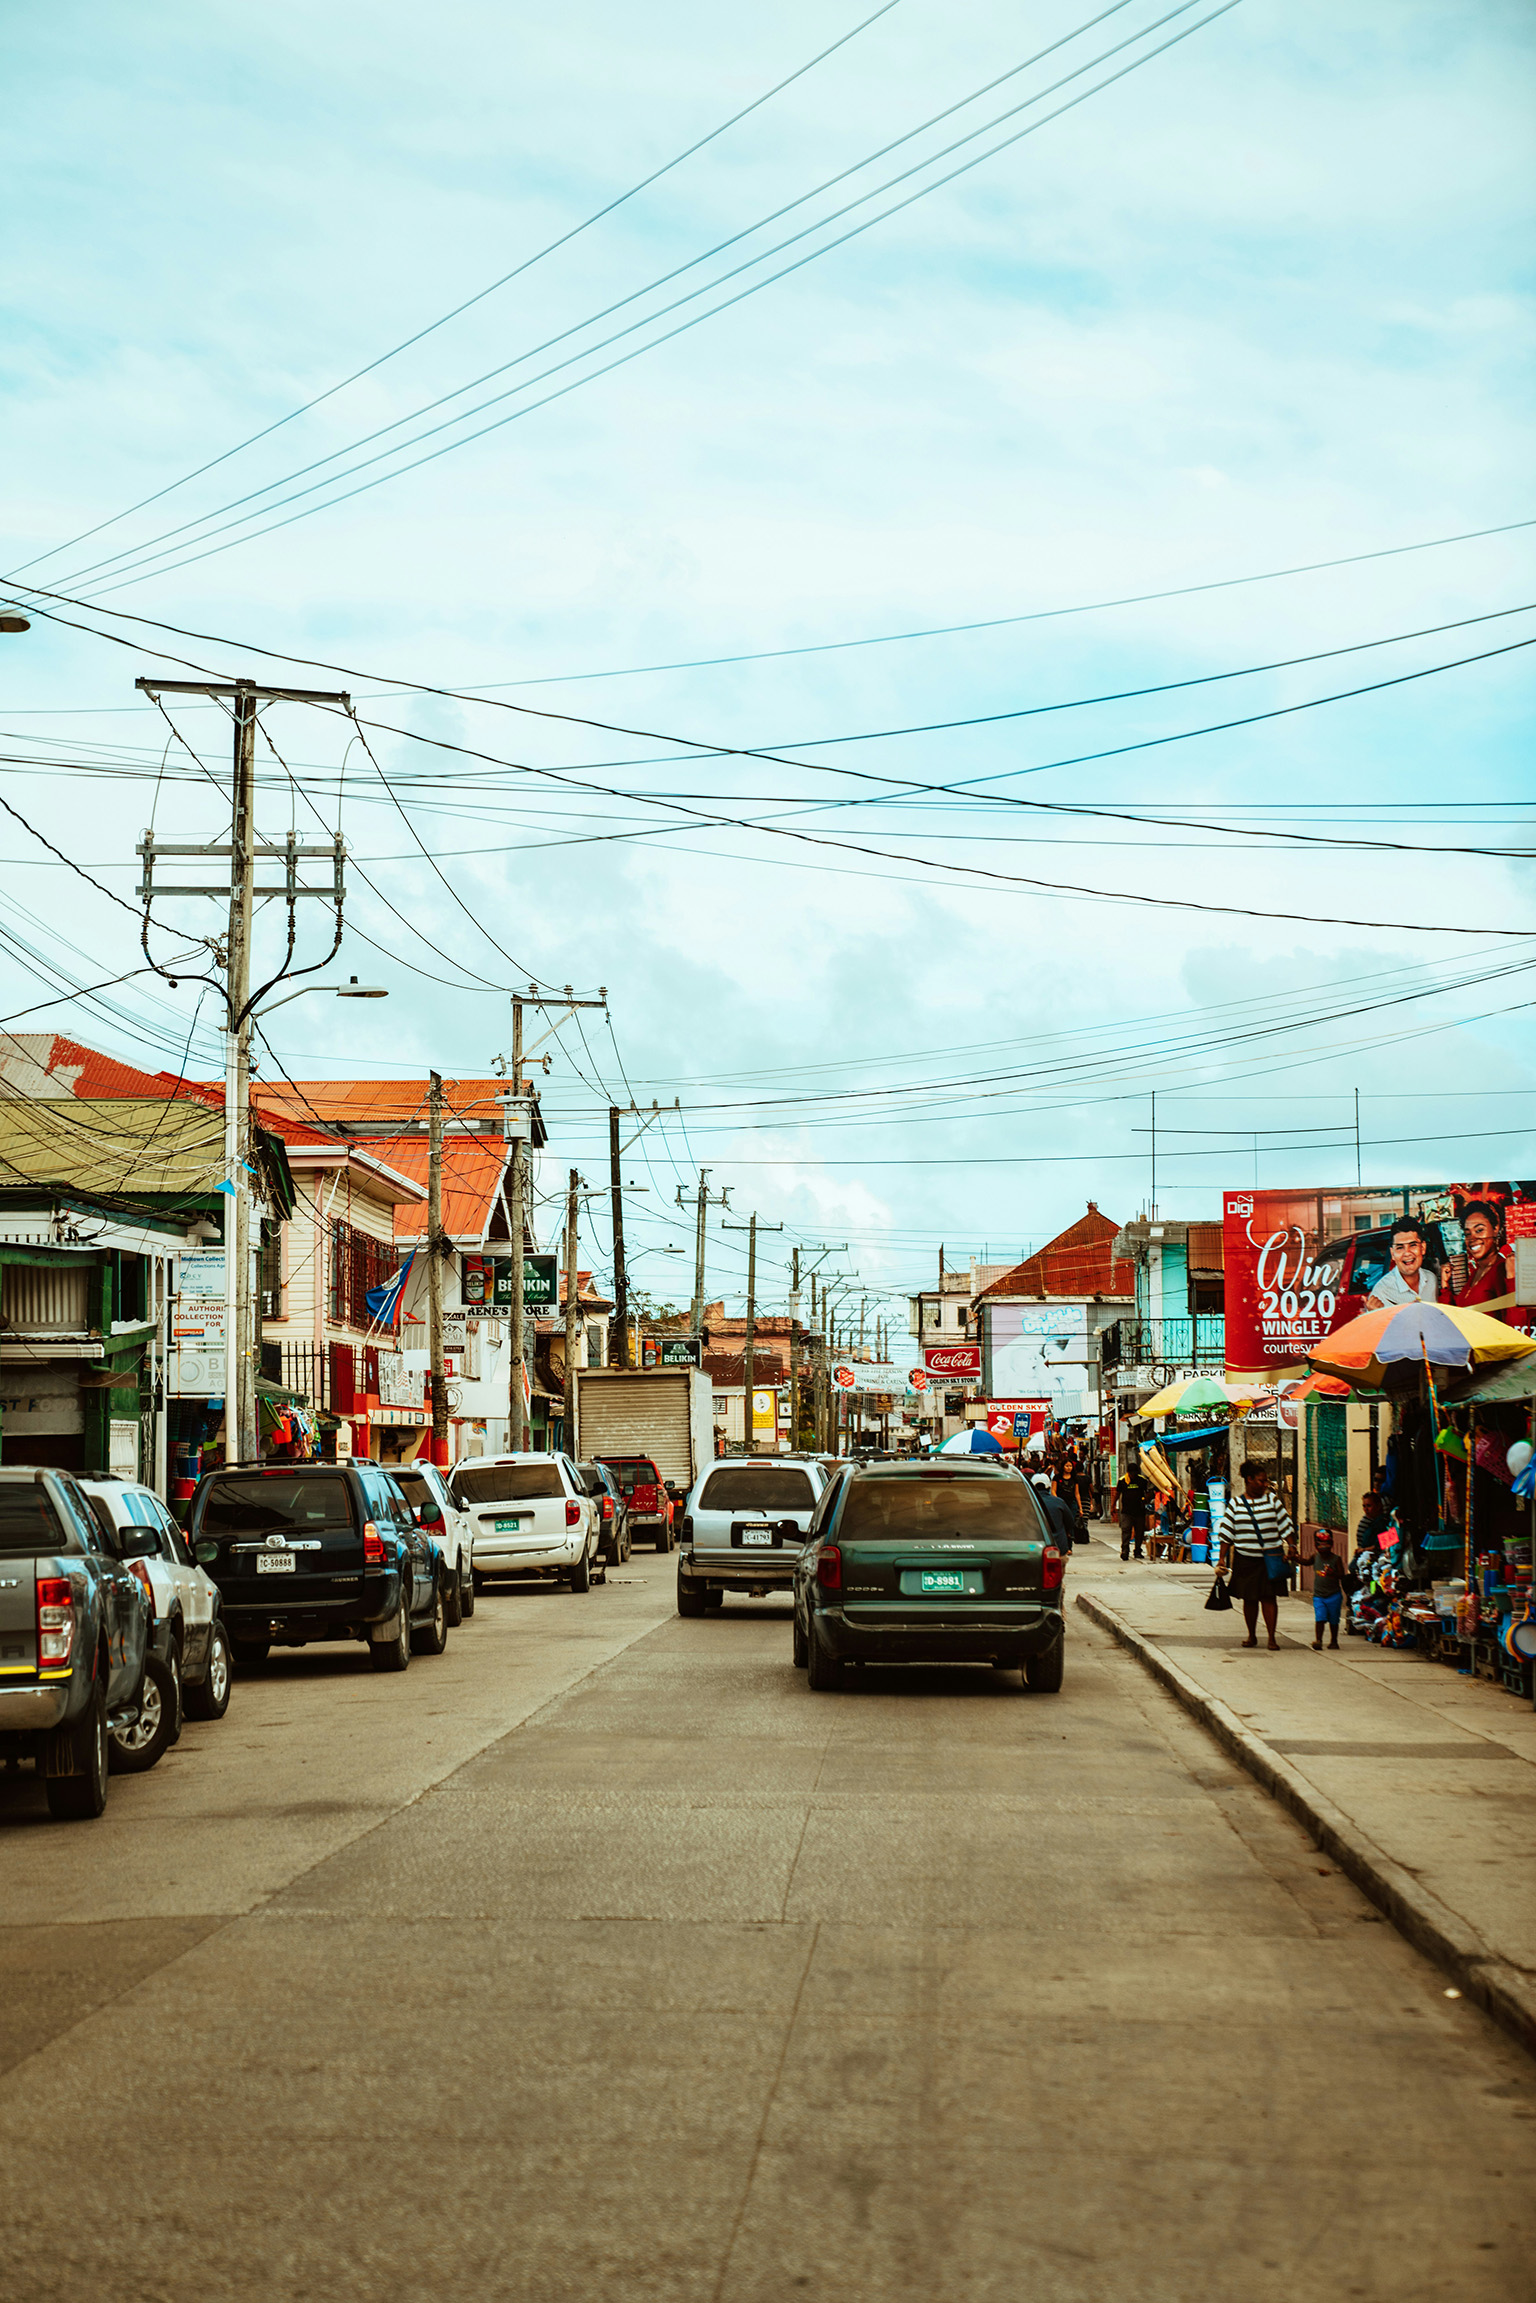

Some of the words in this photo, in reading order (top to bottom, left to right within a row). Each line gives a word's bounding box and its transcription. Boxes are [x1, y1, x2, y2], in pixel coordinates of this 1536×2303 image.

[1227, 1201, 1254, 1218] Digi
[1246, 1219, 1339, 1291] Win
[498, 1279, 550, 1292] BEIKIN
[1262, 1289, 1336, 1319] 2020
[1261, 1320, 1320, 1335] WINGLE
[1322, 1320, 1332, 1334] 7
[1263, 1342, 1312, 1355] courtesy
[664, 1354, 697, 1363] BELIKIN
